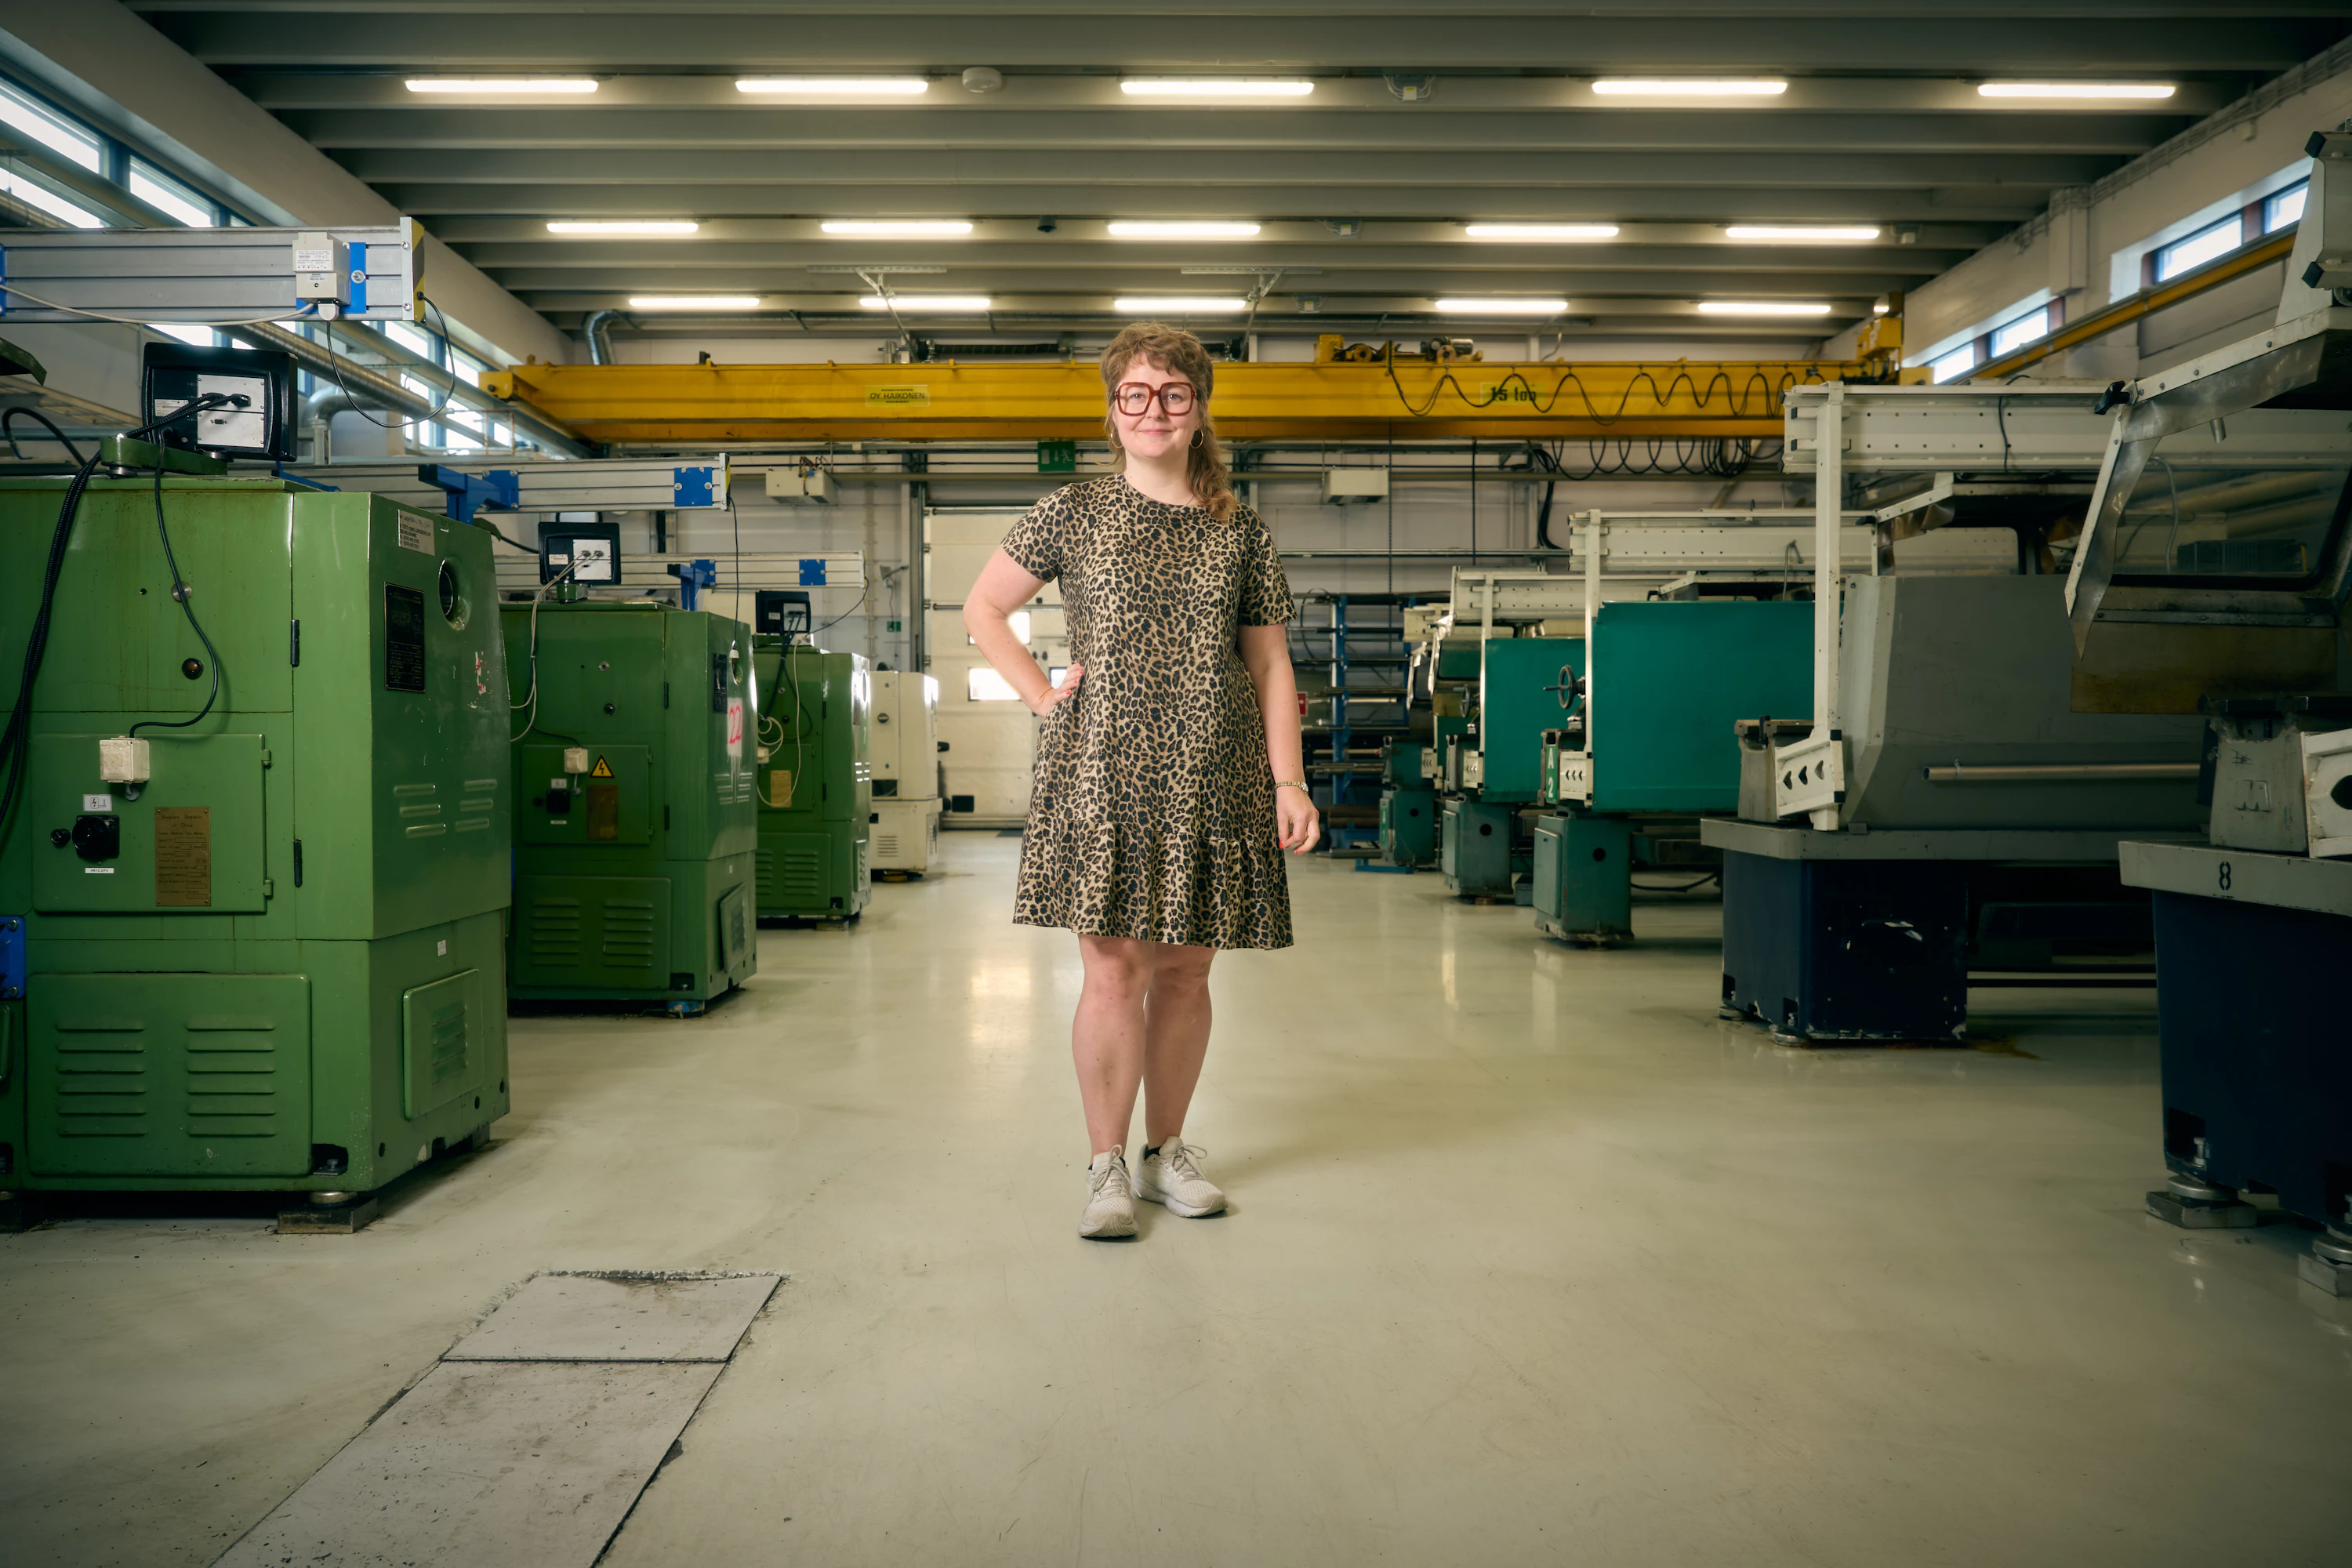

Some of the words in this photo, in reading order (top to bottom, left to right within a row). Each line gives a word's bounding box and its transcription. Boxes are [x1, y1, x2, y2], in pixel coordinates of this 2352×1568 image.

[1491, 387, 1508, 401] 15
[728, 704, 741, 744] 22
[1548, 747, 1555, 769] A
[1548, 776, 1554, 798] 2
[2219, 860, 2231, 891] 8
